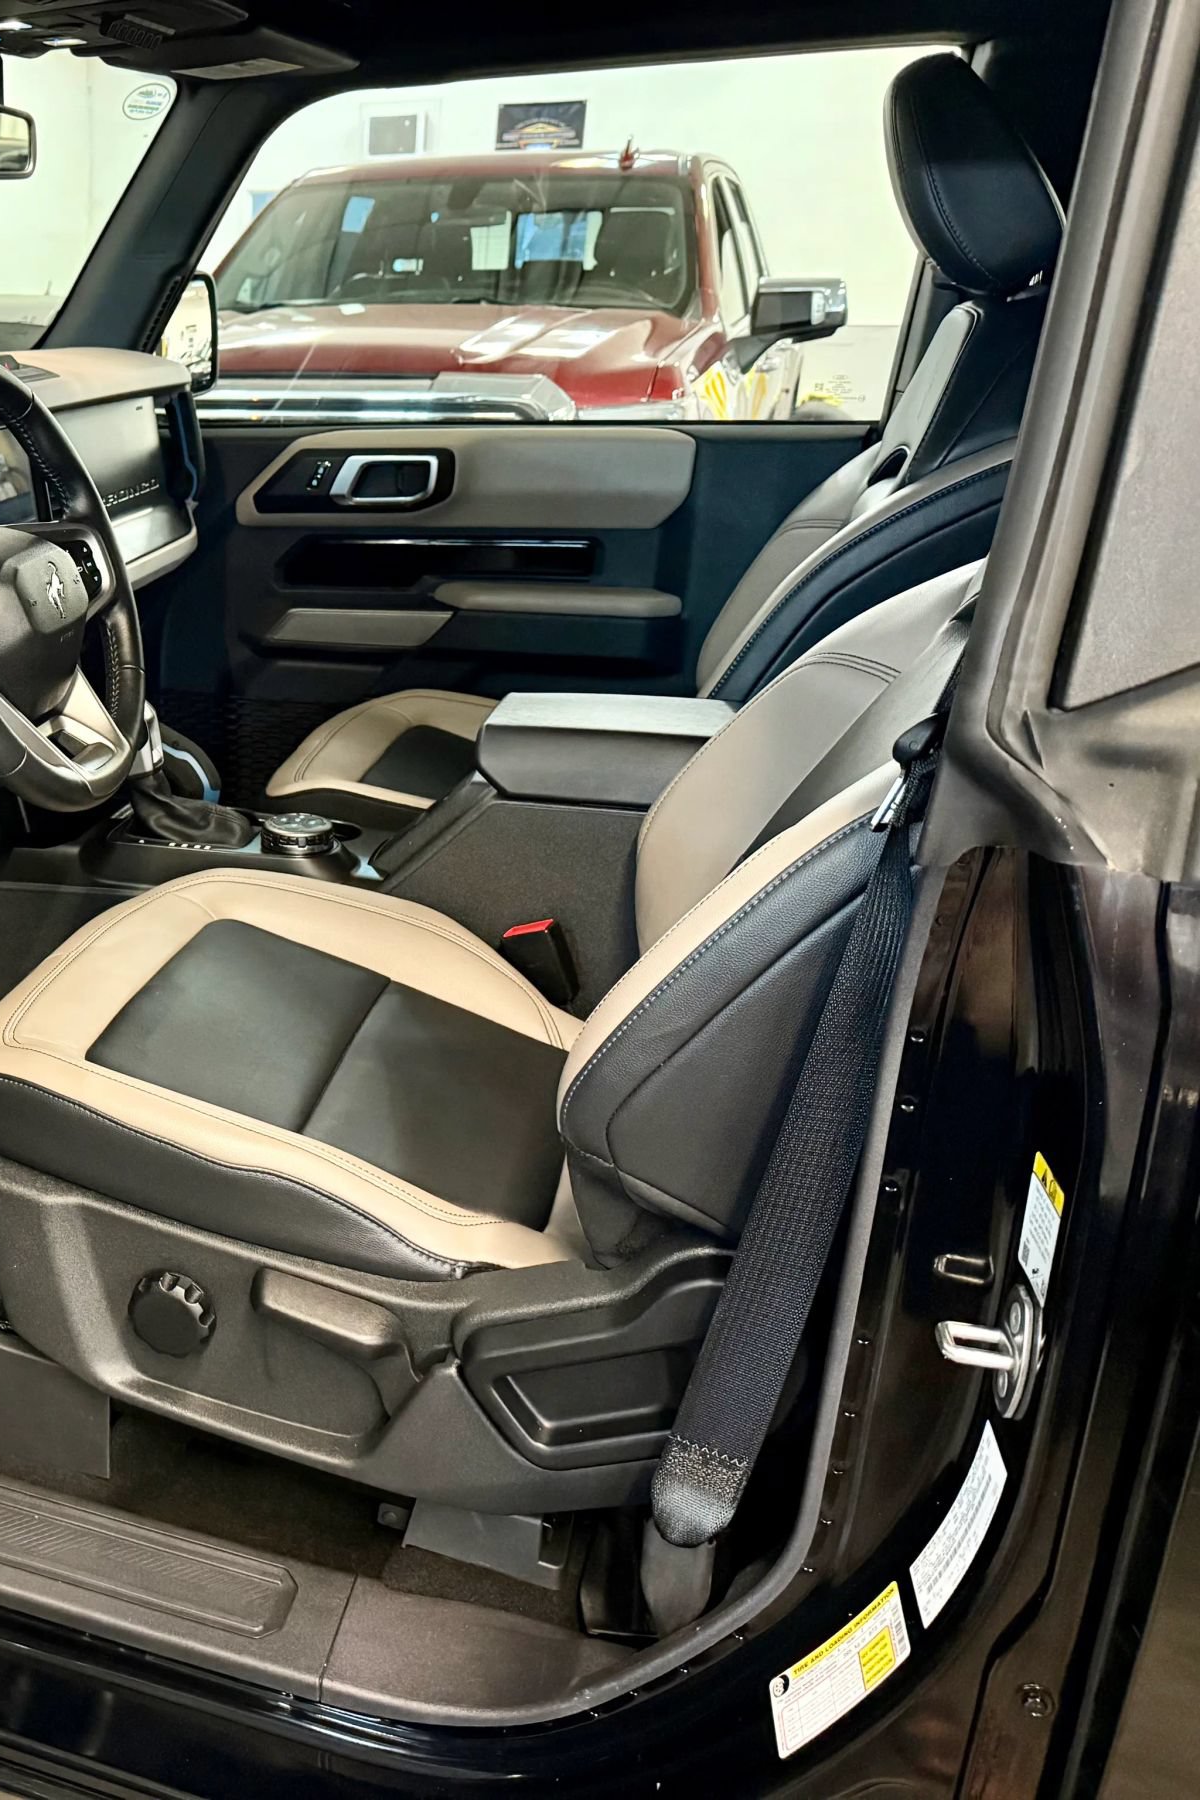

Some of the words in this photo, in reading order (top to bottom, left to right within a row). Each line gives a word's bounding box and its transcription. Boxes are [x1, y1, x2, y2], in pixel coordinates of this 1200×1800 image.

[793, 1662, 809, 1676] TIRE
[810, 1650, 825, 1664] AND
[825, 1627, 853, 1652] LOADING
[853, 1587, 895, 1630] INFORMATION
